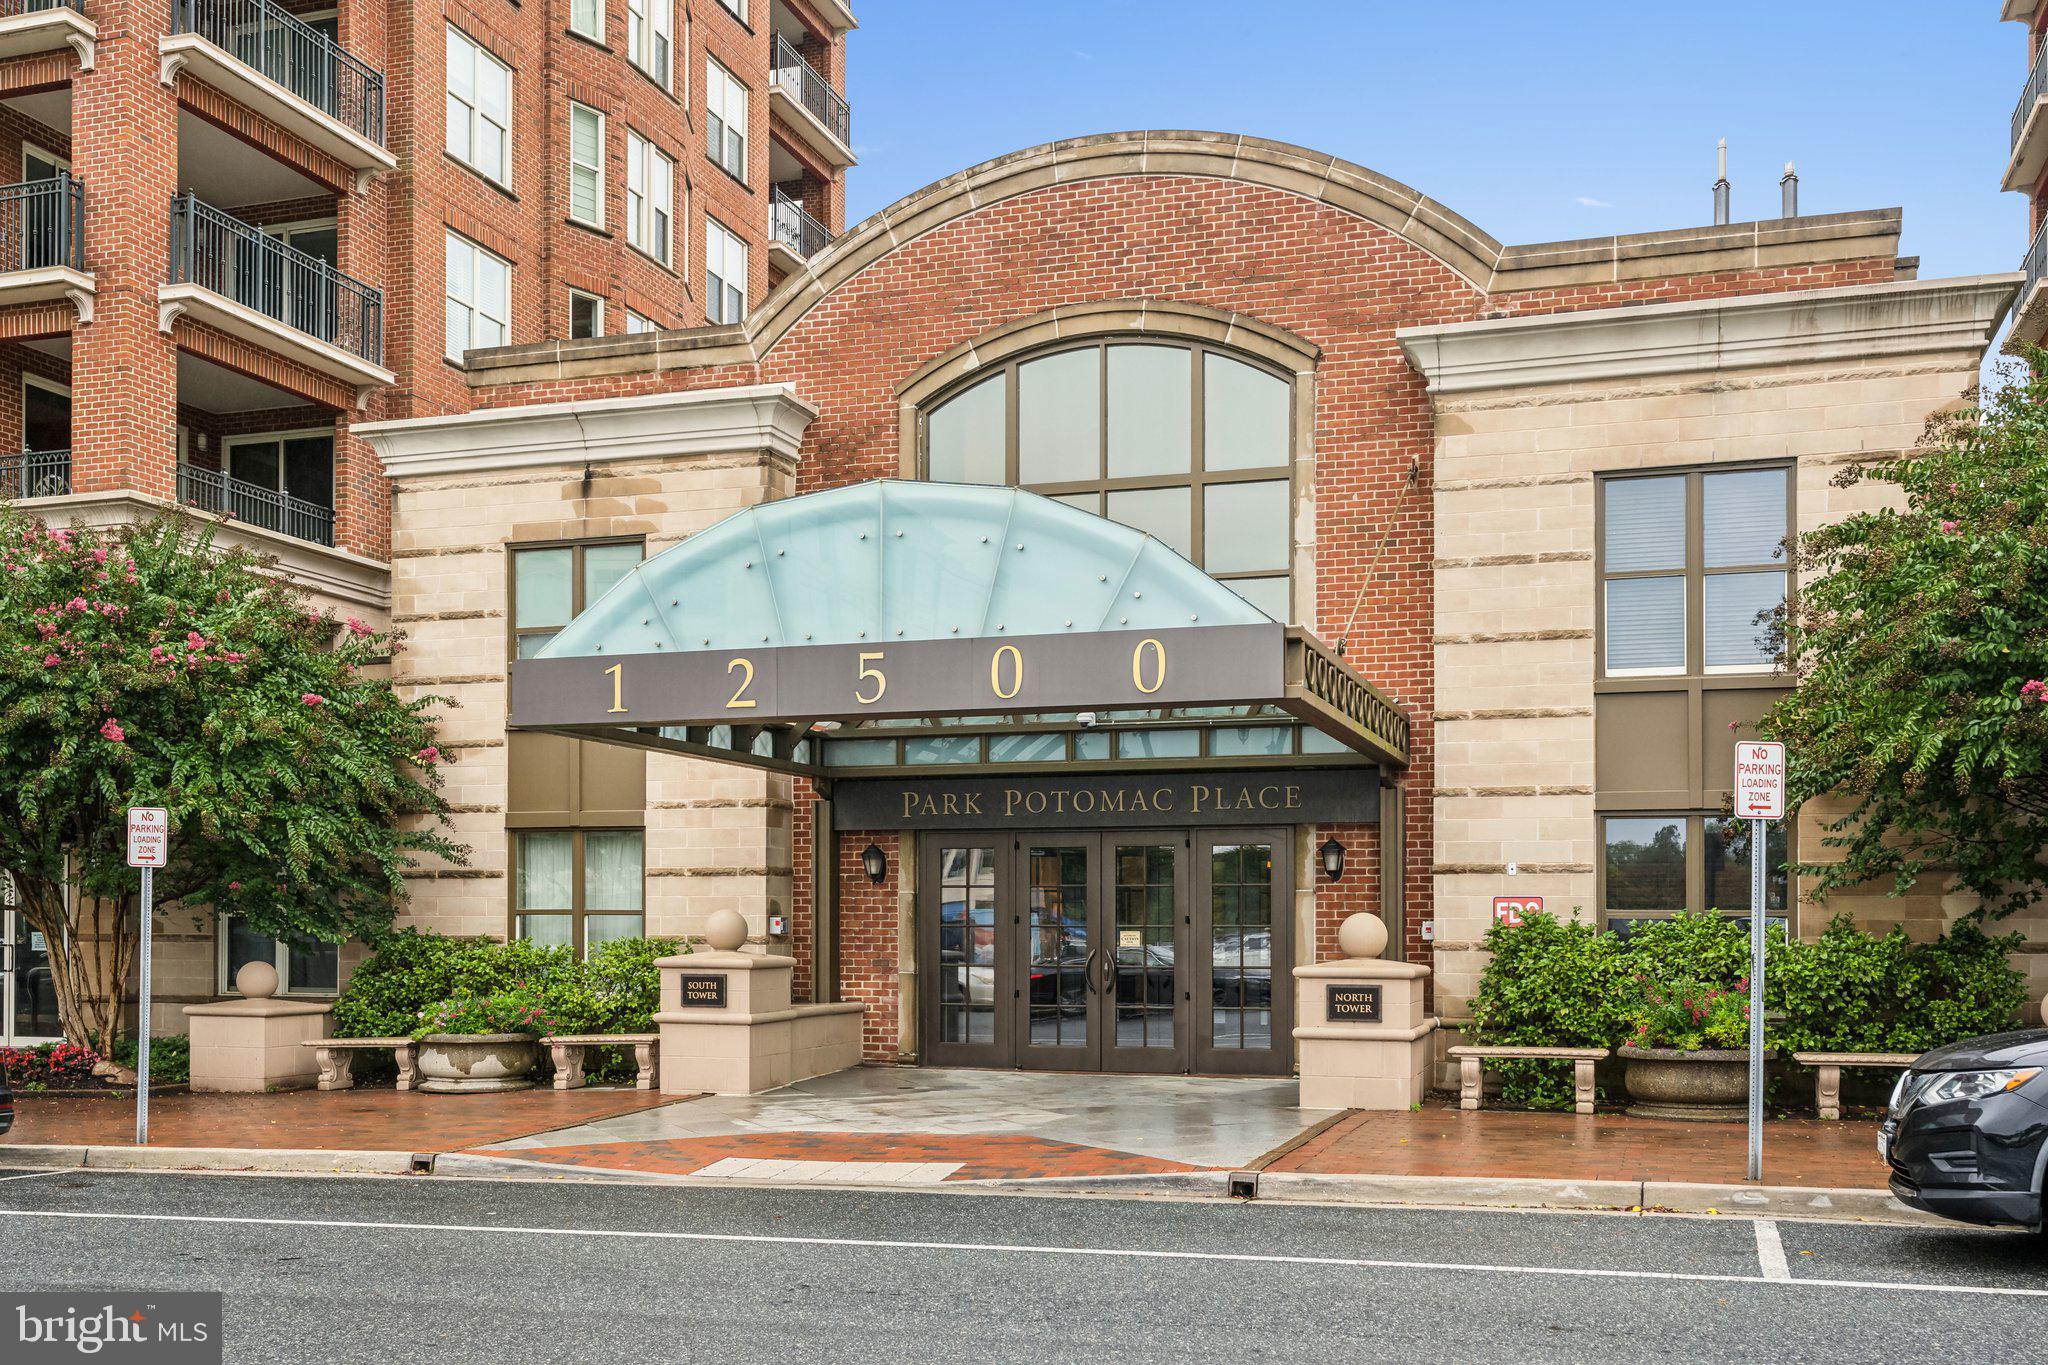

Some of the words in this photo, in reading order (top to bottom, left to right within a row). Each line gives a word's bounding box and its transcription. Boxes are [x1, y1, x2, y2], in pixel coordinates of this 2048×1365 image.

[1752, 749, 1768, 760] NO
[1739, 763, 1782, 775] PARKING
[1741, 778, 1778, 788] LOADING
[1748, 792, 1771, 801] ZONE
[901, 791, 983, 818] PARK
[1004, 787, 1174, 816] POTOMAC
[1190, 785, 1303, 813] PLACE
[141, 813, 155, 822] NO
[131, 824, 164, 833] PARKING
[133, 835, 162, 843] LOADING
[138, 846, 156, 854] ZONE
[687, 981, 717, 990] SOUTH
[687, 991, 718, 999] TOWER
[1335, 993, 1373, 1002] NORTH
[1334, 1004, 1373, 1013] TOWER
